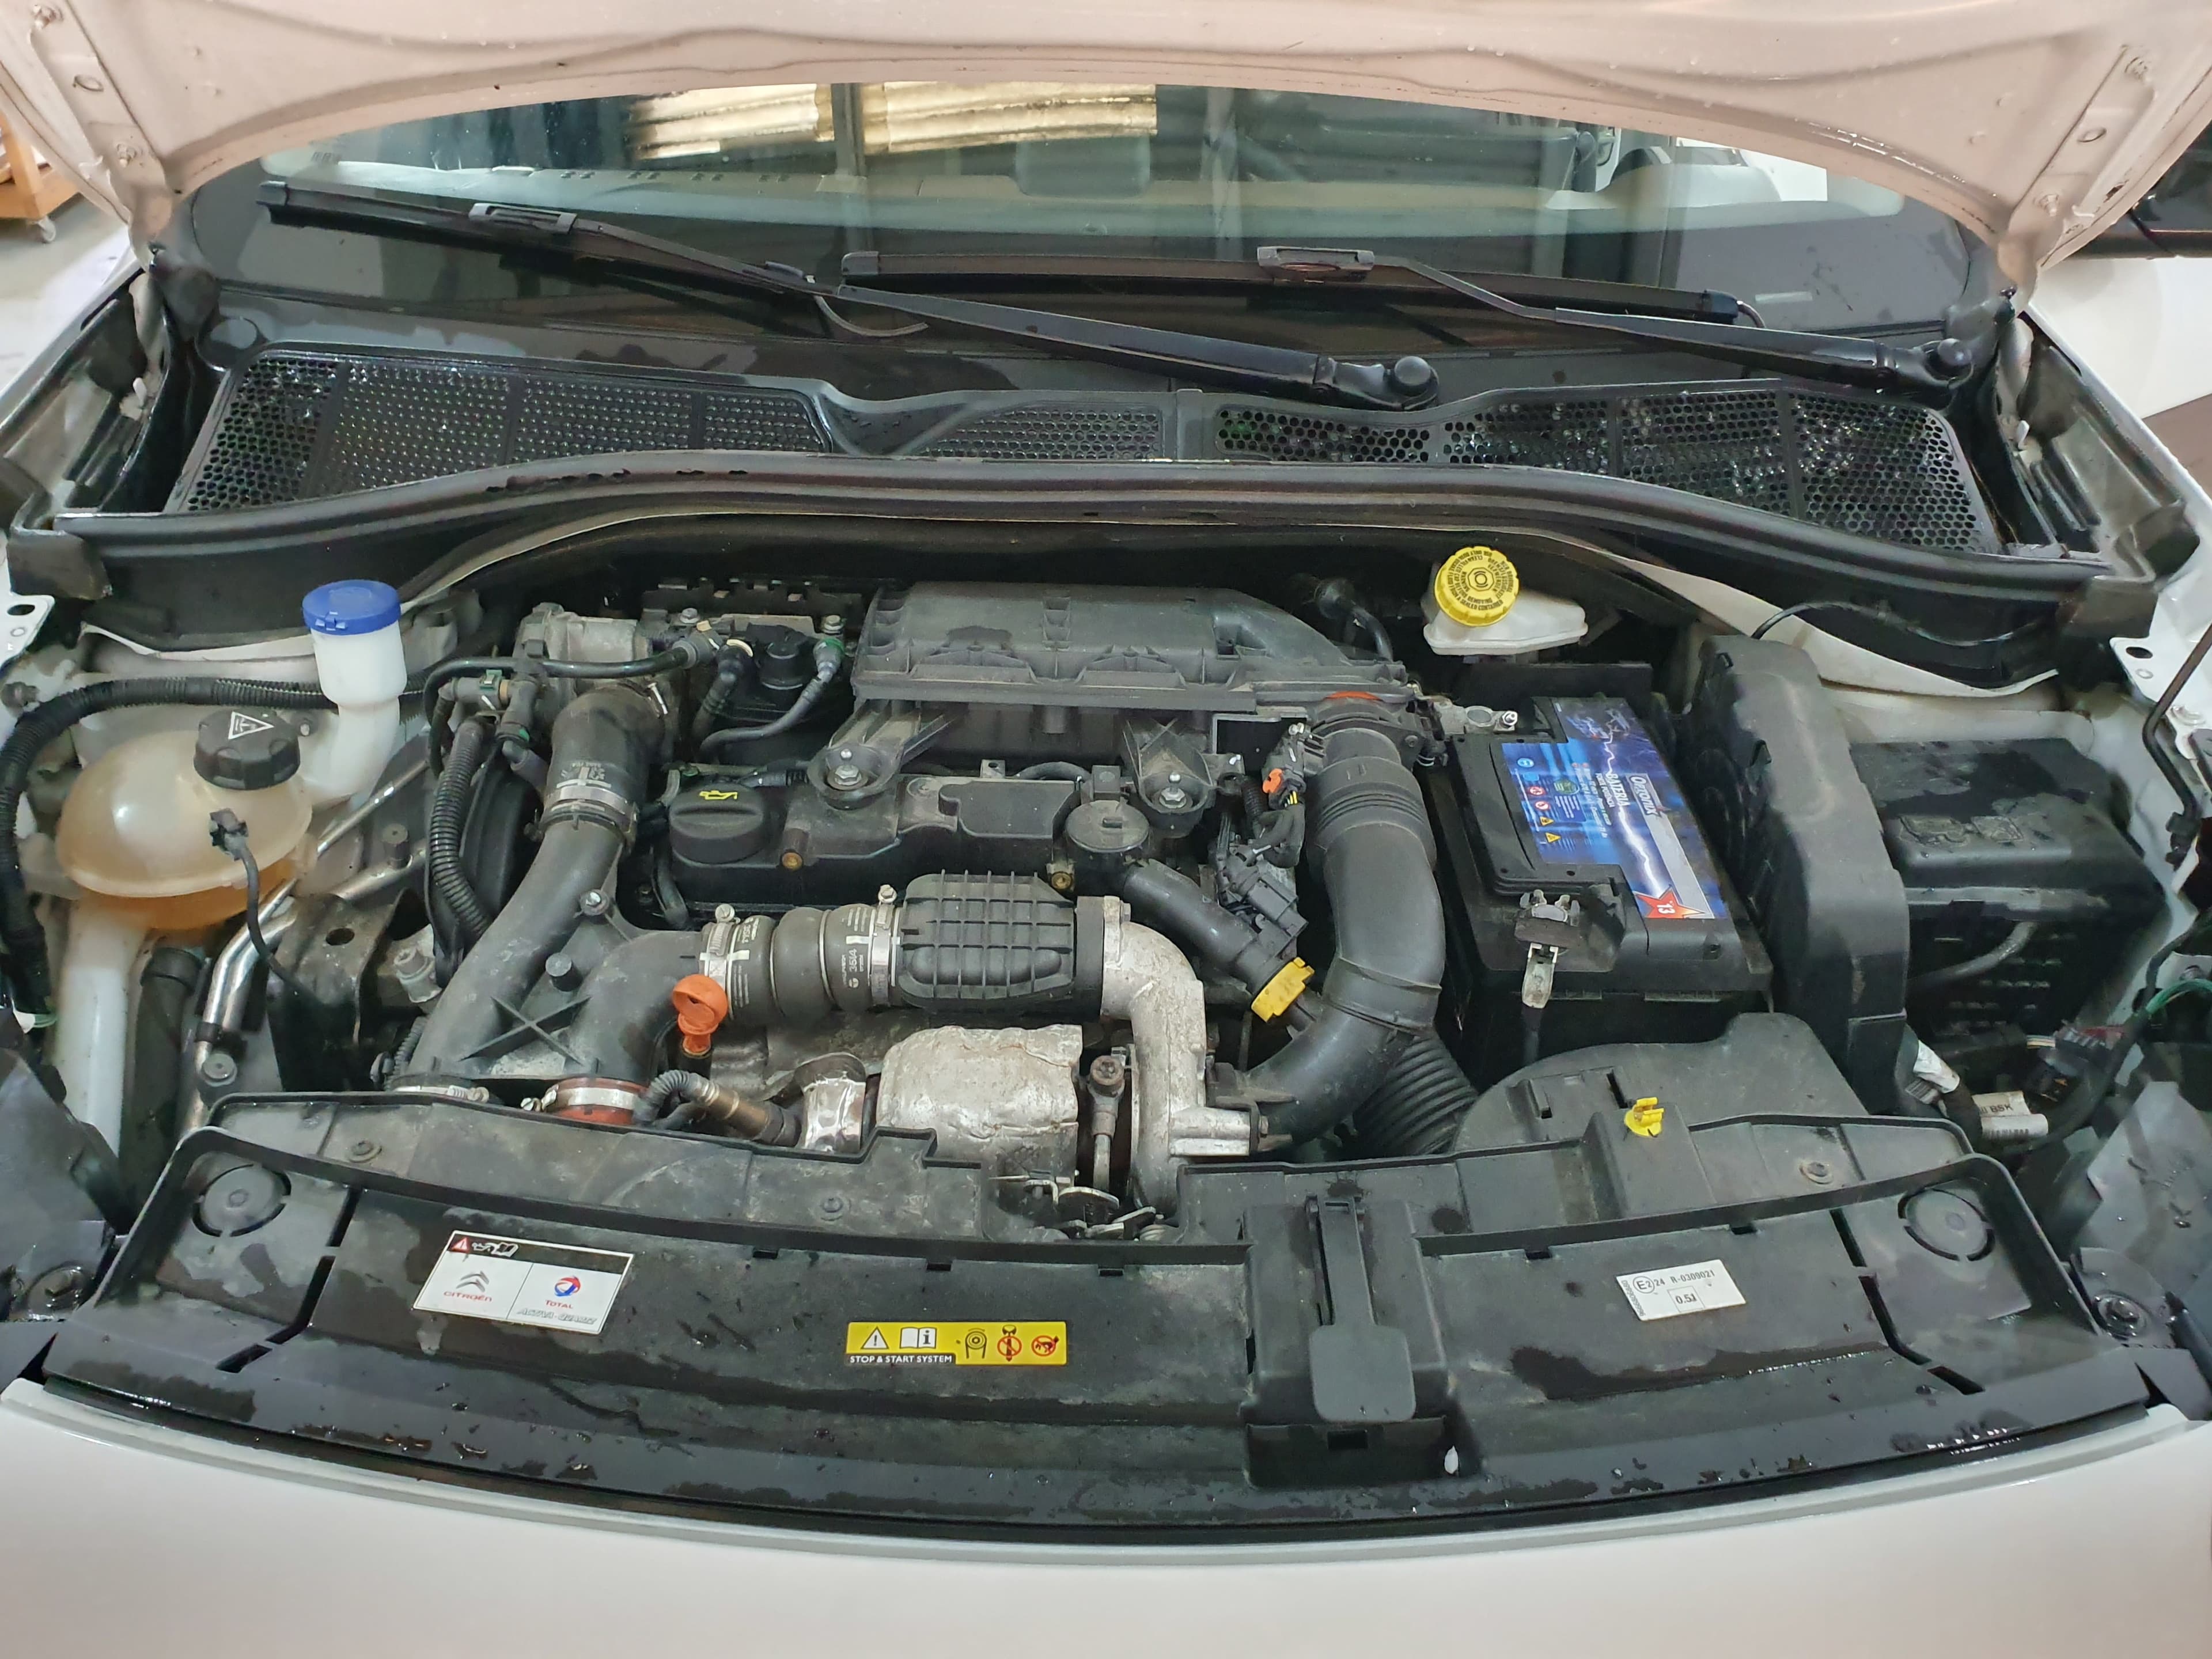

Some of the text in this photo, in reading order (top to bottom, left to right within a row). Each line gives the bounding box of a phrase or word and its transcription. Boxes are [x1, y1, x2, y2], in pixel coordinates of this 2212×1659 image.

[1605, 773, 1631, 806] BATERIA
[1655, 1279, 1665, 1287] 24
[544, 1299, 574, 1309] TOTAL
[850, 1355, 952, 1363] STOP & START SYSTEM
